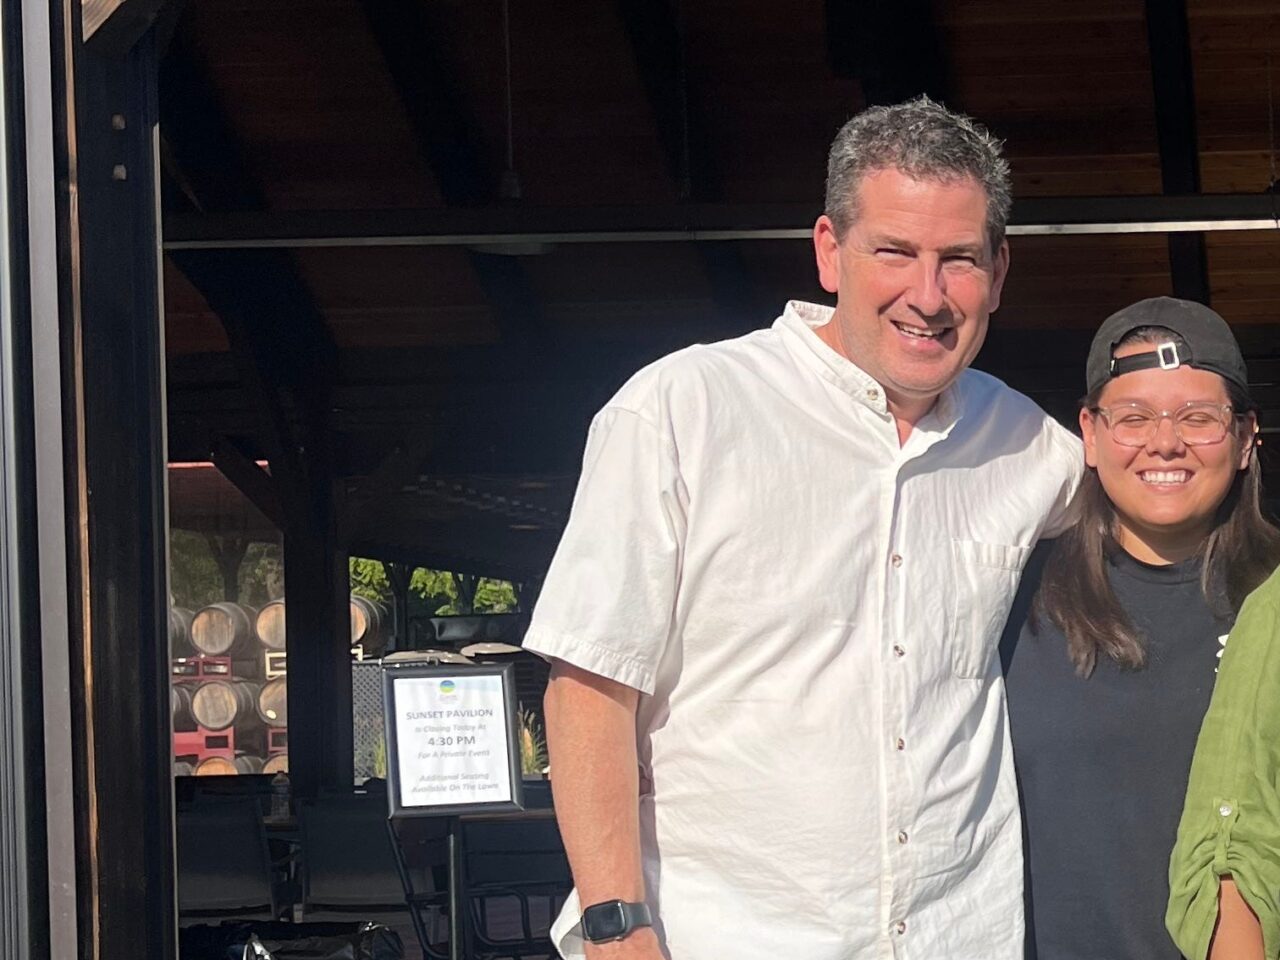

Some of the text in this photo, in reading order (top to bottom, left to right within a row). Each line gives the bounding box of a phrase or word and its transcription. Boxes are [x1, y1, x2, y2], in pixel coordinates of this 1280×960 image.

[406, 709, 493, 720] SUNSET PAVILION
[428, 736, 476, 746] 4:30 PM
